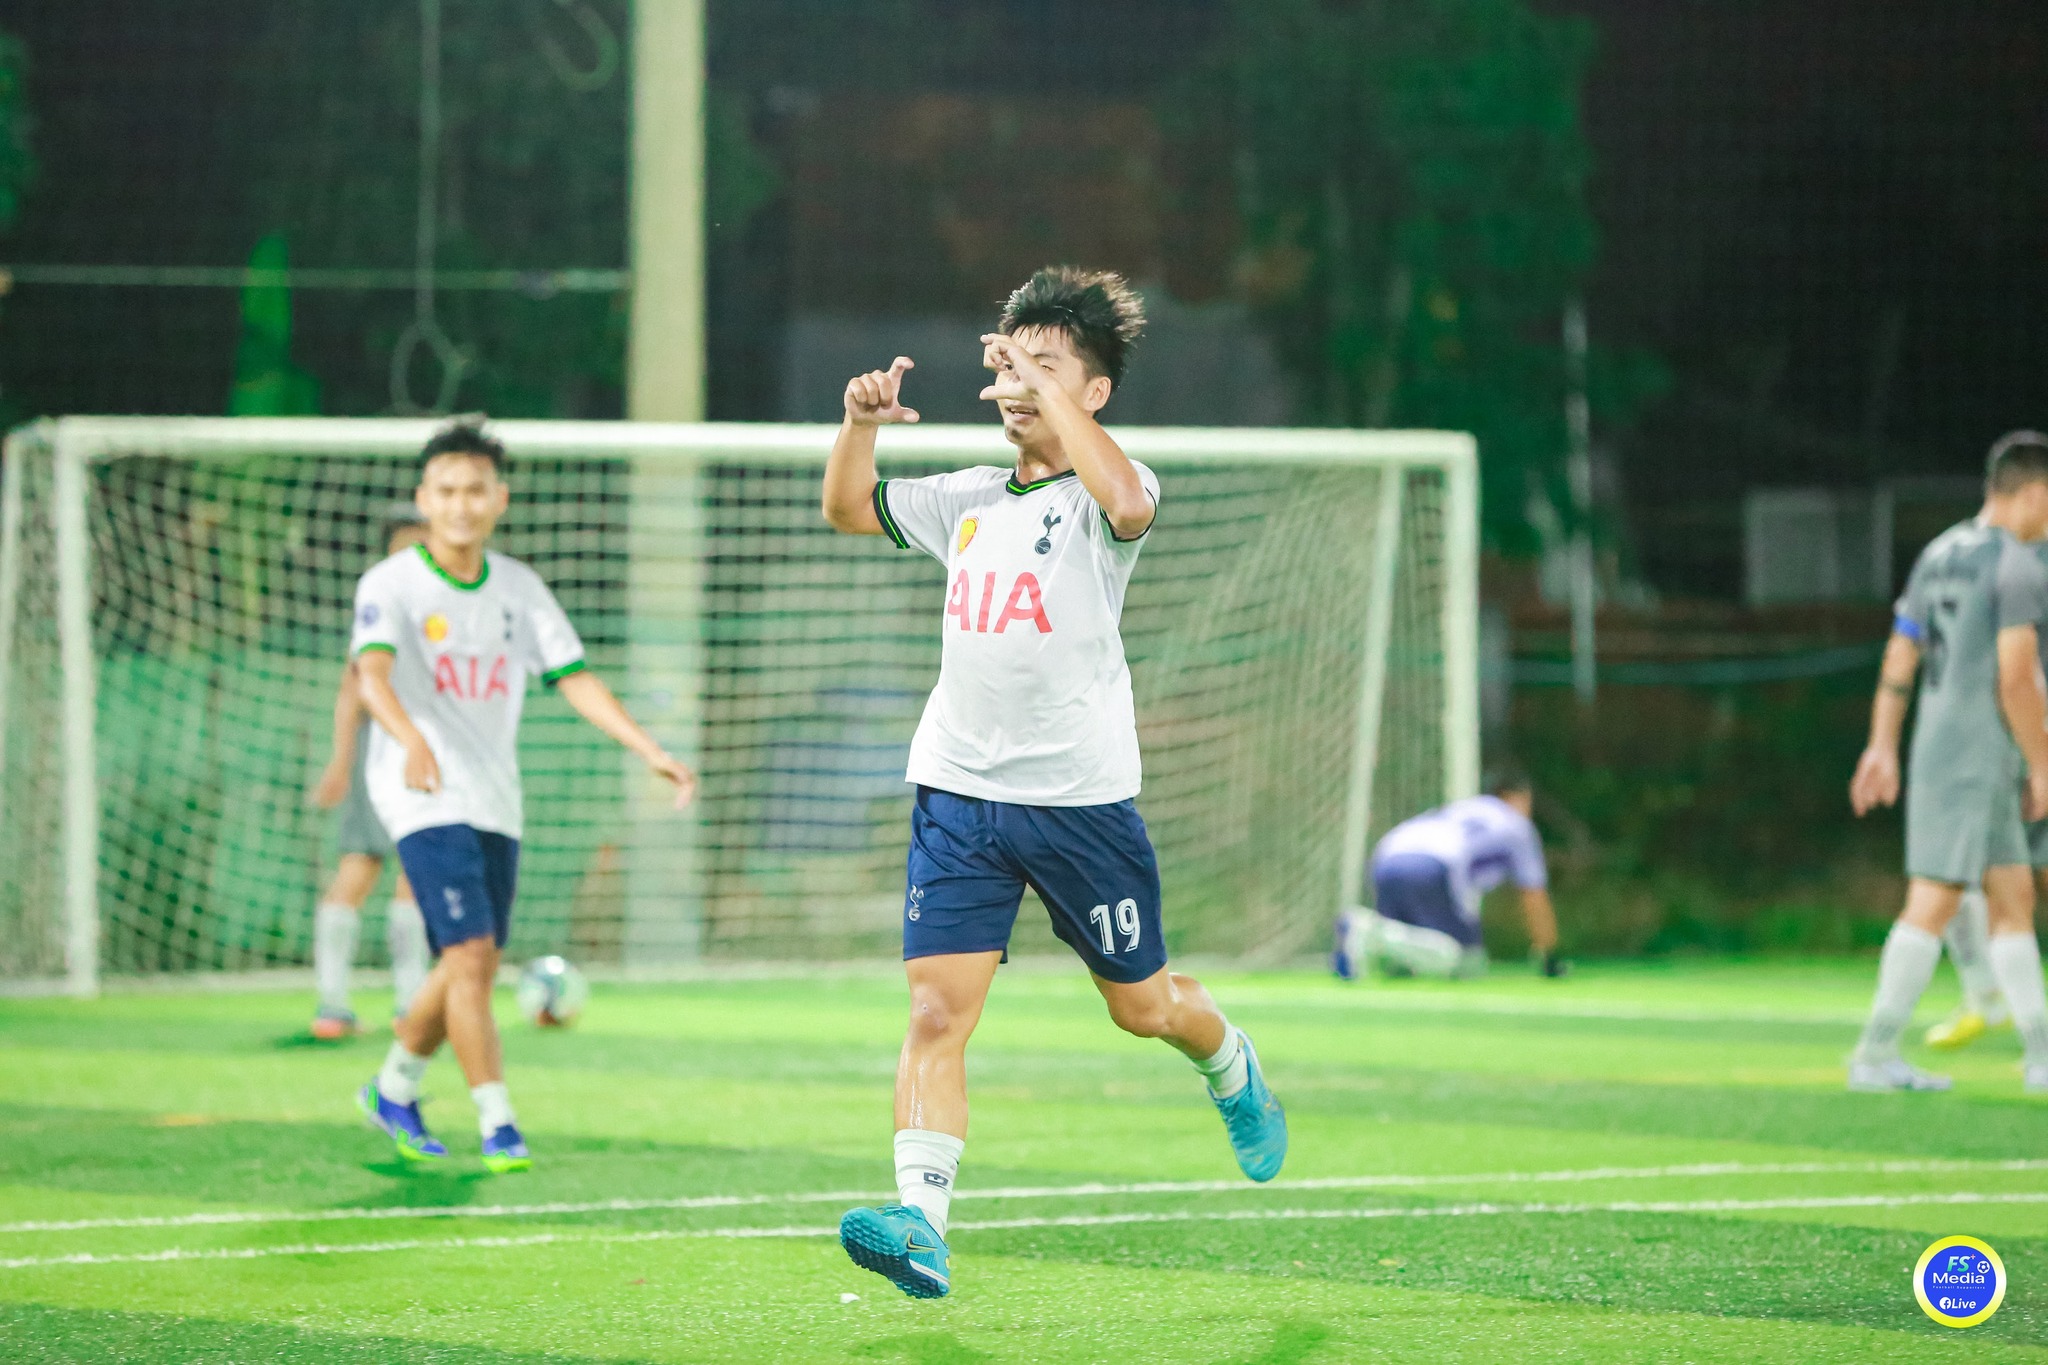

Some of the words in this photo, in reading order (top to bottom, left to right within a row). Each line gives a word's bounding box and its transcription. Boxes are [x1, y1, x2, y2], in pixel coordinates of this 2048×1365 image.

[947, 568, 1053, 634] AIA
[435, 654, 509, 702] AIA
[1089, 897, 1141, 955] 19
